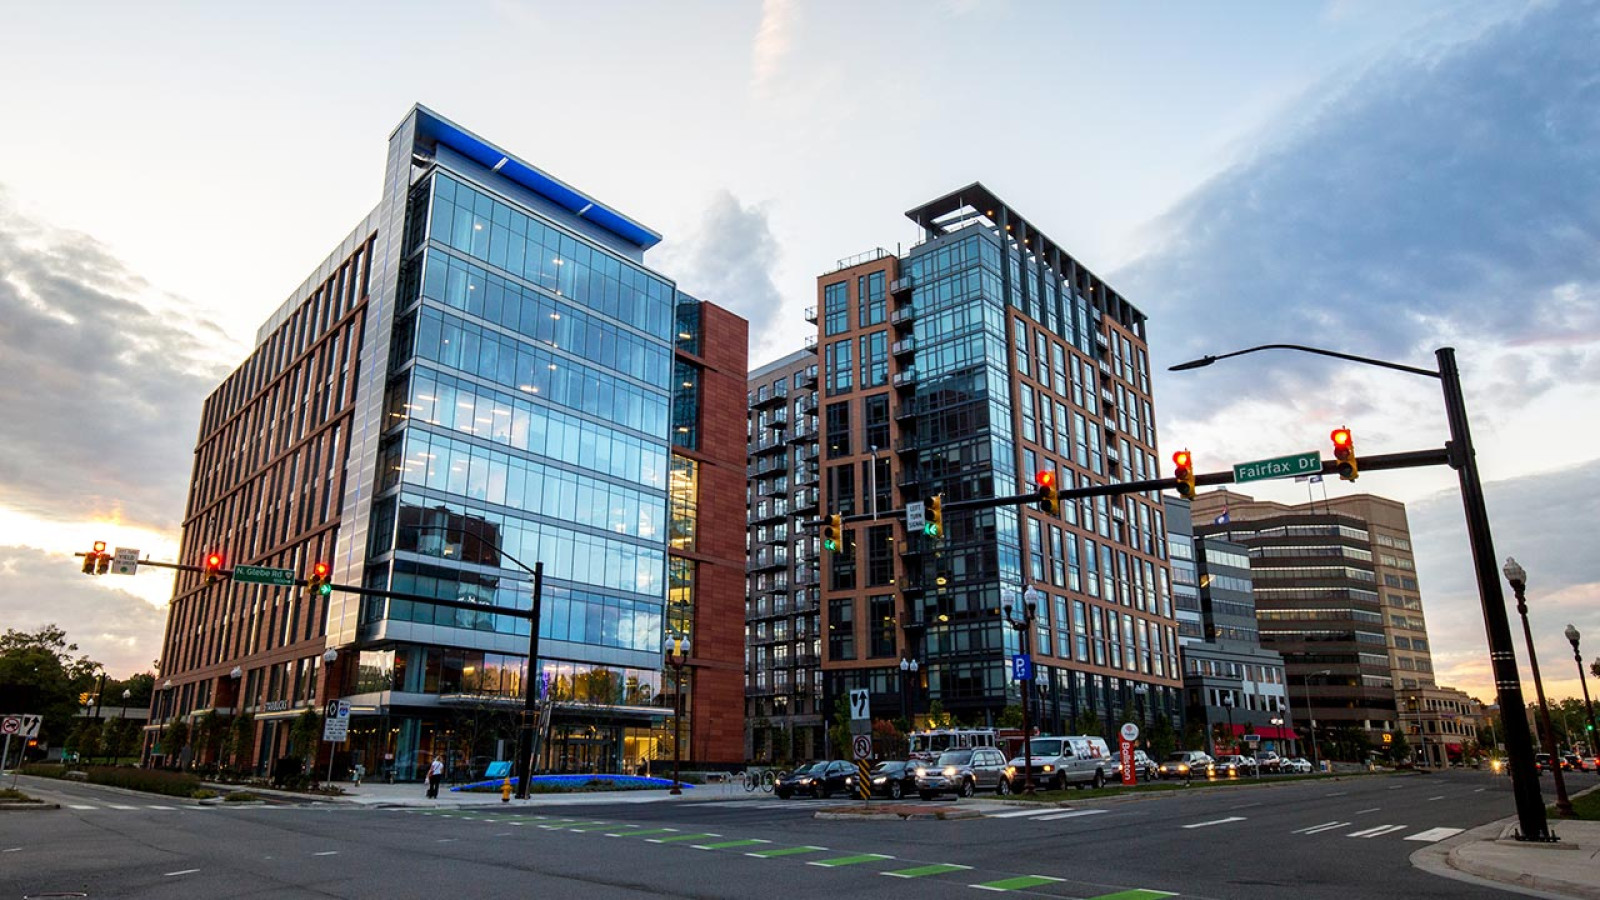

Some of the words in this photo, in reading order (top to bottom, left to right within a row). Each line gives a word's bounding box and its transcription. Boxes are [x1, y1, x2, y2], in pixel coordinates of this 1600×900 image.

[1239, 462, 1290, 479] Fairfax
[1298, 457, 1316, 470] Dr
[908, 521, 925, 529] SIGNAL
[246, 568, 270, 577] Glebe
[271, 570, 283, 578] Rd
[1015, 658, 1025, 673] P
[1121, 742, 1131, 780] Ballston
